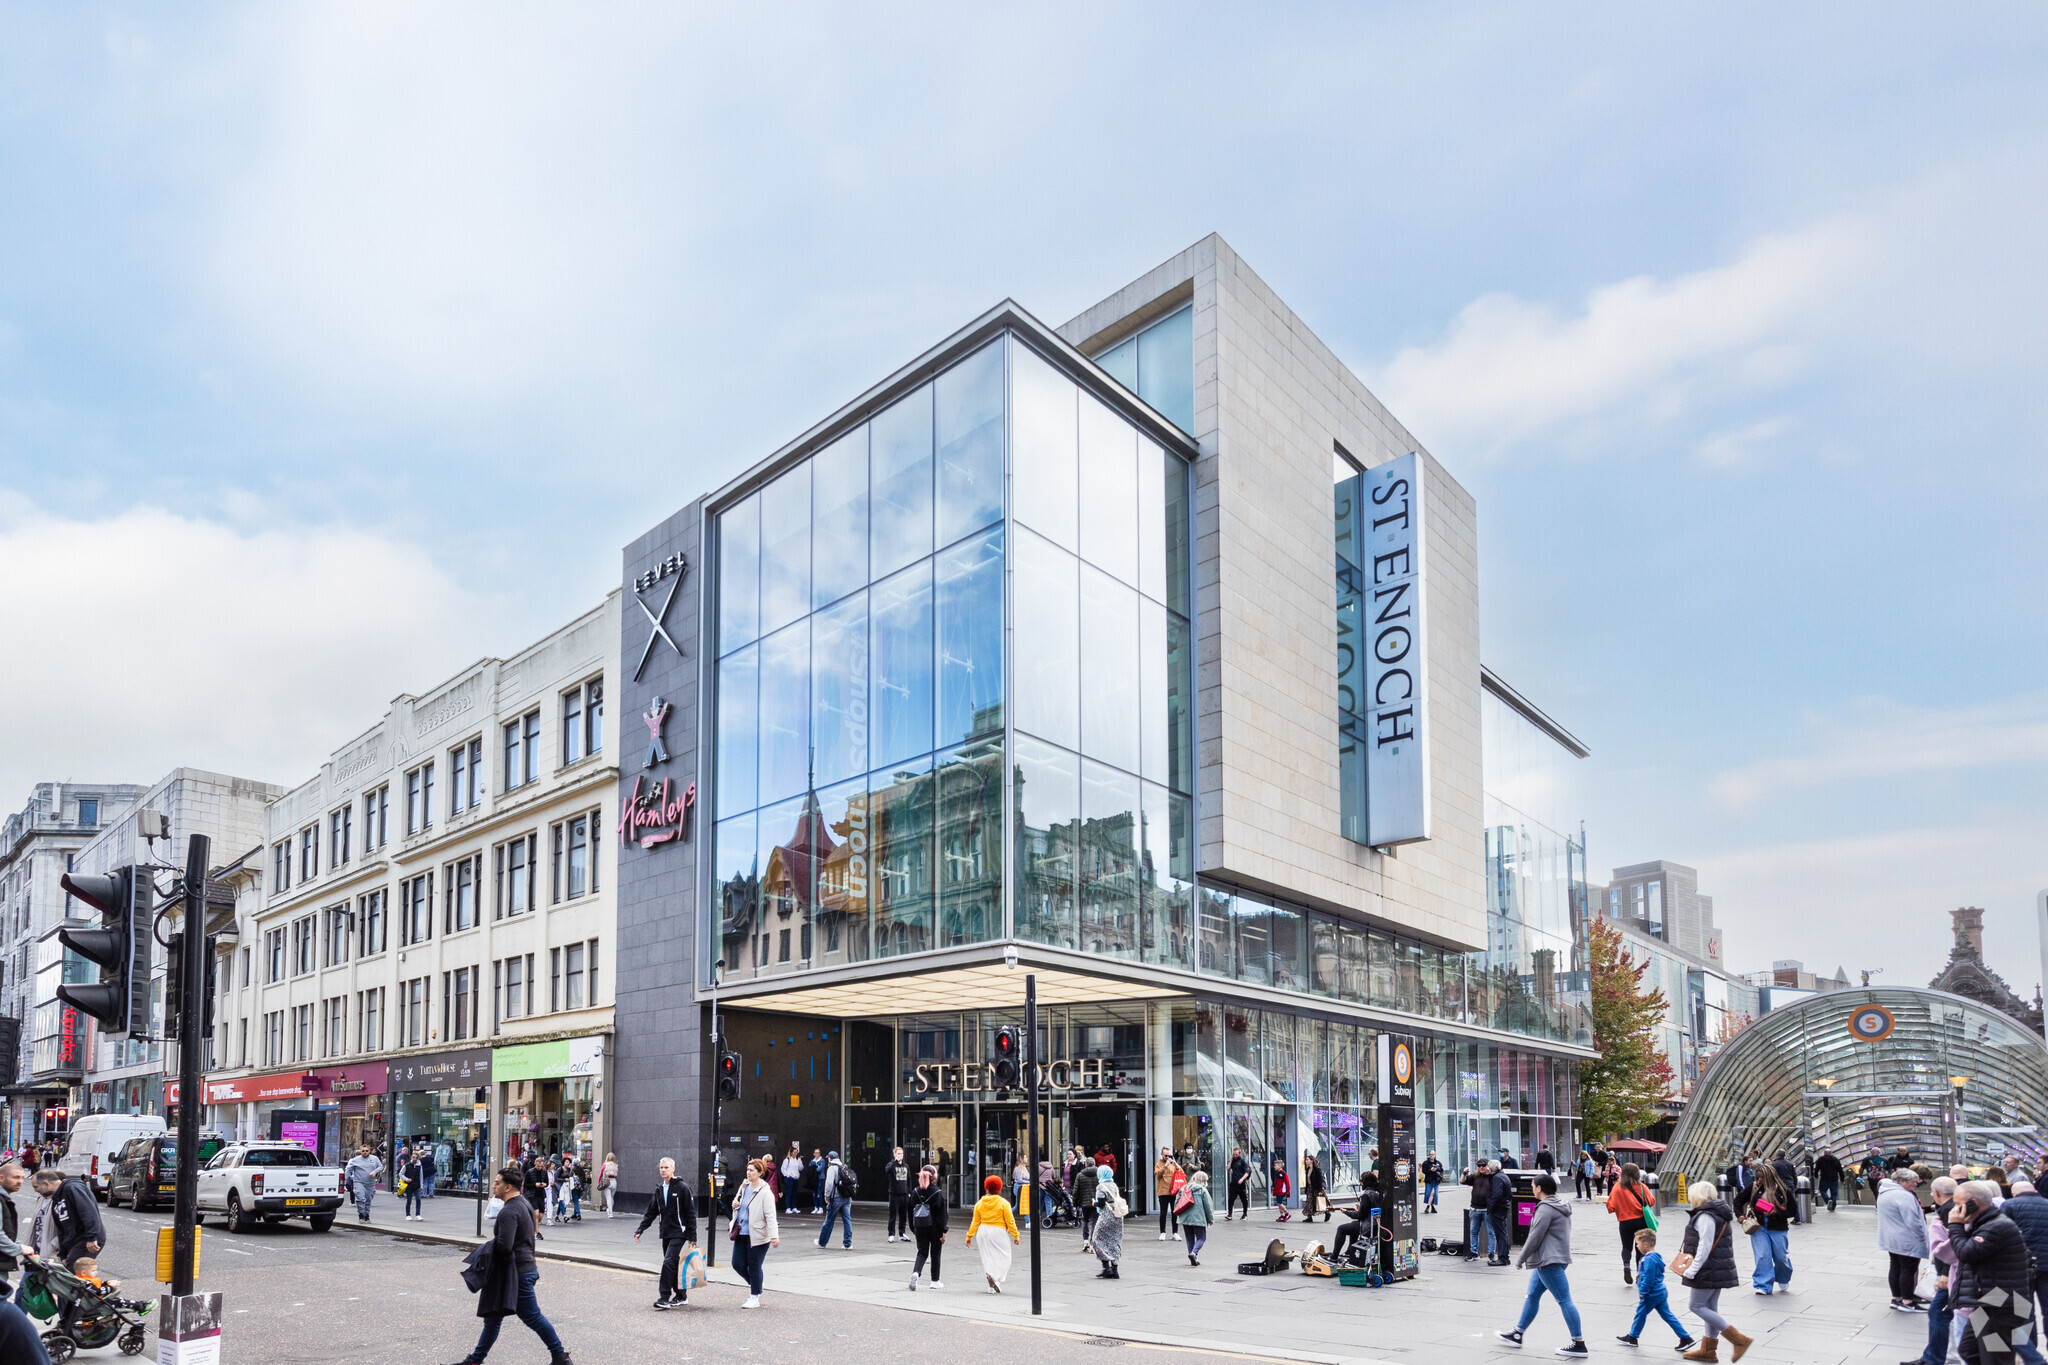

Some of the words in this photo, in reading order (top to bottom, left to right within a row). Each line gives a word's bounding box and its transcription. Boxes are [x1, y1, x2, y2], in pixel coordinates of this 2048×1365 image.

[1372, 478, 1409, 532] ST
[633, 551, 686, 593] LEVEL
[1373, 543, 1414, 749] ENOCH
[616, 774, 695, 849] Hamleys
[1865, 1016, 1877, 1029] S
[440, 1062, 456, 1073] HOUSE
[544, 1060, 569, 1075] inside
[570, 1057, 591, 1073] out
[1400, 1056, 1405, 1069] S
[915, 1064, 950, 1093] ST
[1394, 1084, 1412, 1099] Subway
